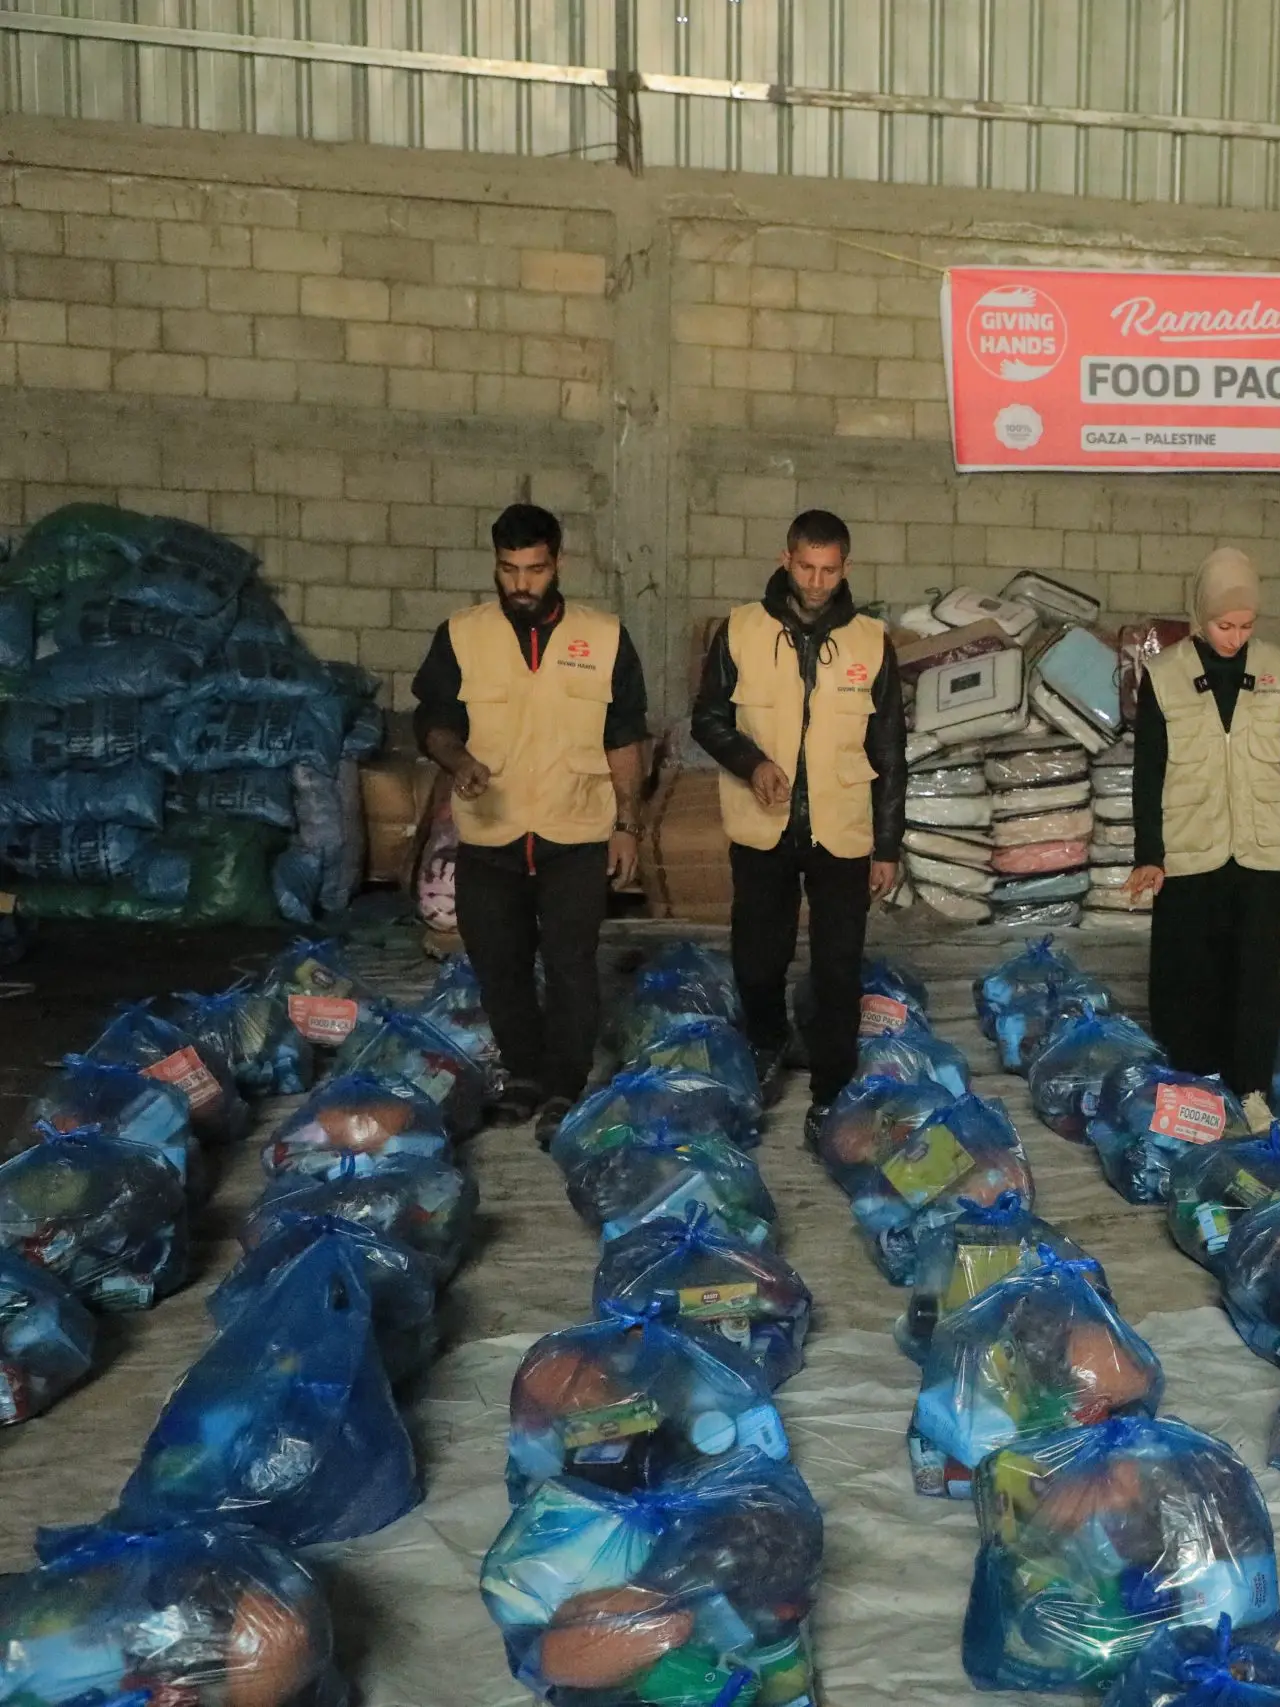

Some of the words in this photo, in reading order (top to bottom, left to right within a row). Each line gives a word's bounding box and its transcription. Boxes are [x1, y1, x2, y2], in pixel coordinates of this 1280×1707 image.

[981, 311, 1054, 331] GIVING
[980, 335, 1056, 355] HANDS
[1088, 363, 1200, 398] FOOD
[1086, 432, 1128, 445] GAZA
[1144, 432, 1217, 446] PALESTINE
[862, 1012, 882, 1022] FOOD
[1179, 1106, 1200, 1121] FOOD
[1200, 1111, 1220, 1128] PACK
